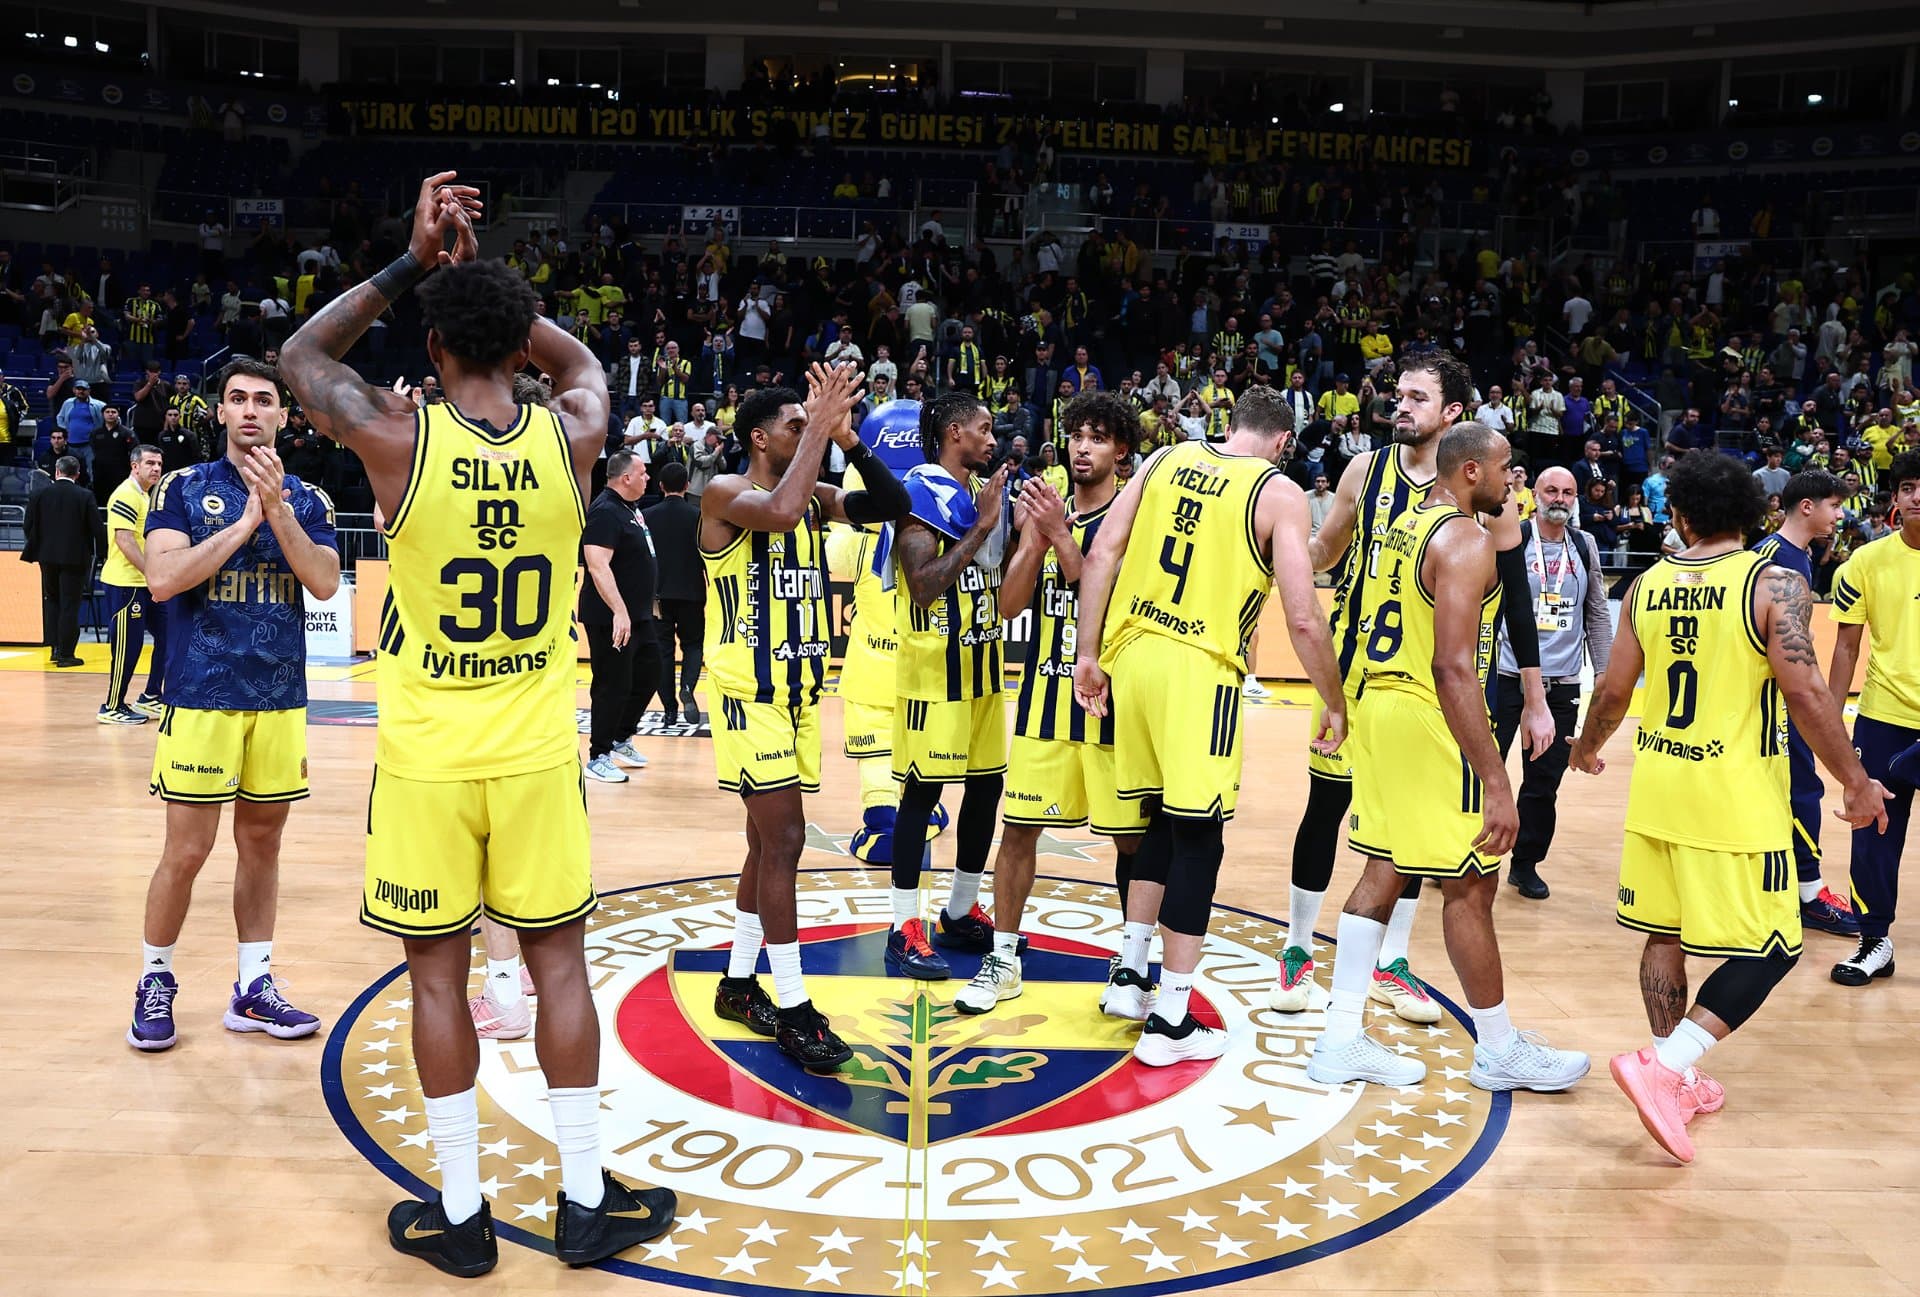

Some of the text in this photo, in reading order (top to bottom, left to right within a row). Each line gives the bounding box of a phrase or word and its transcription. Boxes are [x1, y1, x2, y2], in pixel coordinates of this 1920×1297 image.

[427, 103, 577, 135] SPORUNUN
[591, 107, 638, 136] 120
[880, 112, 983, 148] GÜNEŞİ
[256, 201, 277, 211] 215
[1240, 227, 1259, 237] 213
[451, 457, 539, 491] SILVA
[1170, 466, 1230, 498] MELLI
[207, 563, 295, 604] tarfin
[1159, 535, 1194, 605] 4
[439, 554, 552, 642] 30
[747, 562, 760, 647] BILFEN
[976, 594, 996, 625] 21
[1646, 586, 1727, 612] LARKIN
[796, 603, 814, 637] 11
[1366, 599, 1403, 663] 8
[1060, 624, 1078, 656] 9
[1665, 659, 1698, 730] 0
[171, 760, 224, 775] Limak Hotels
[755, 751, 782, 762] Limak
[928, 751, 951, 761] Limak
[1017, 792, 1043, 802] Hotels
